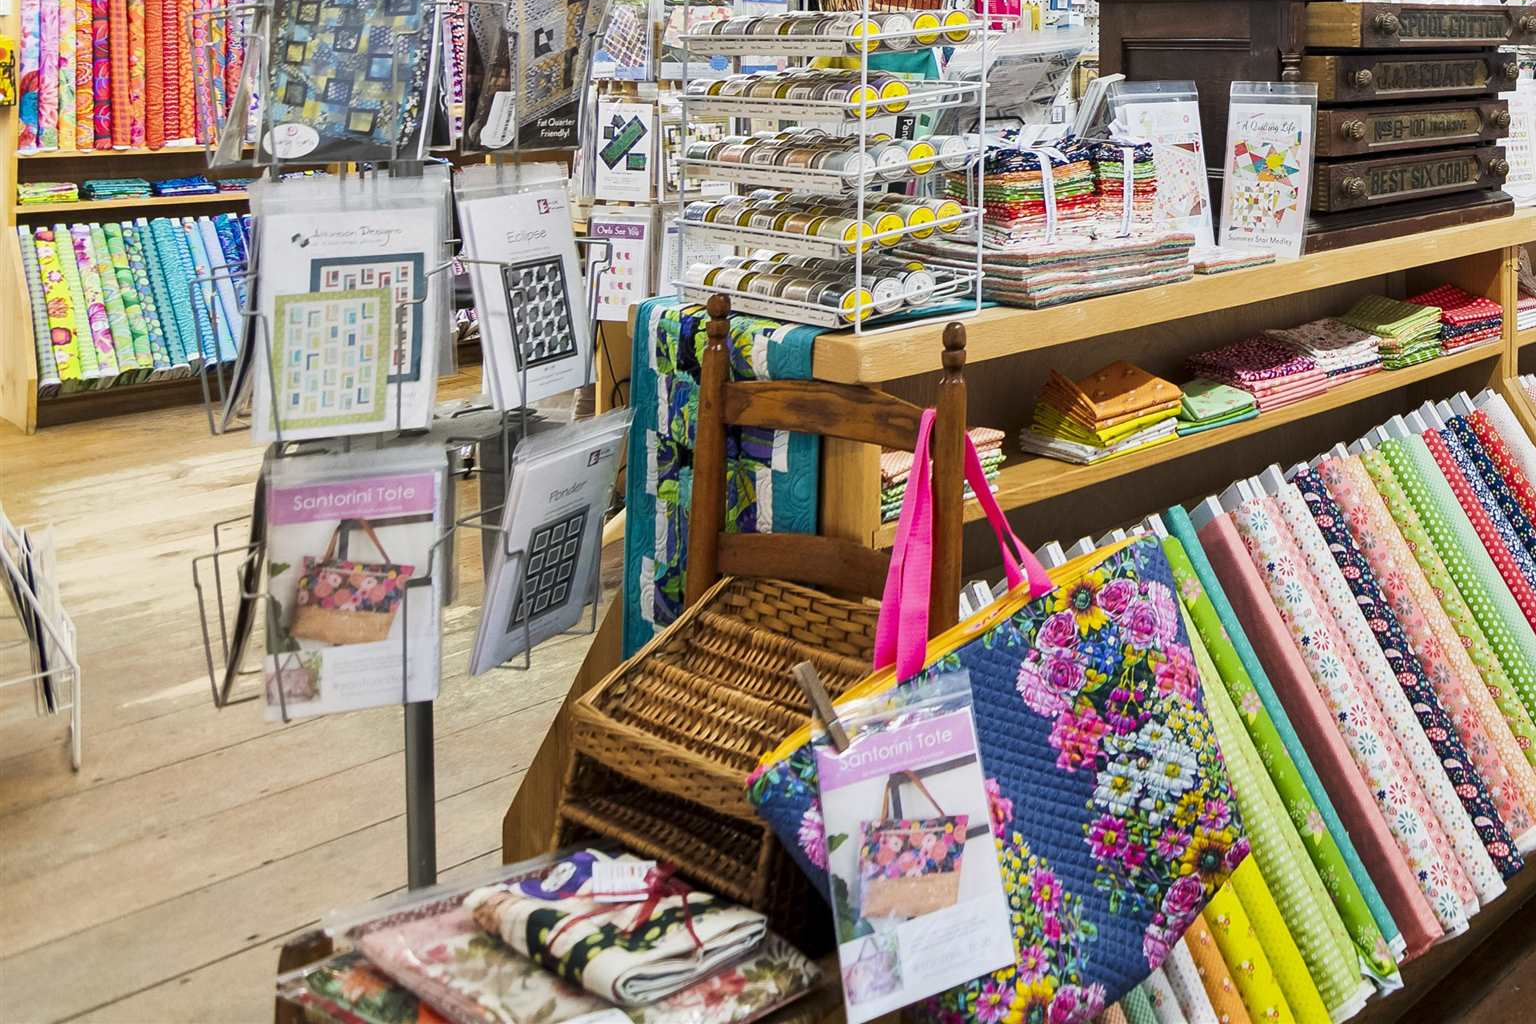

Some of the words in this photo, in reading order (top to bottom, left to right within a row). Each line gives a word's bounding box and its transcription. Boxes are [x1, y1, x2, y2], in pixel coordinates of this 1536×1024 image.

[1400, 13, 1448, 38] SPOOL
[1451, 13, 1506, 39] COTTON
[1419, 62, 1474, 88] COATS
[536, 118, 548, 127] Fat
[548, 117, 575, 127] Quarter
[541, 128, 570, 139] Friendly!
[1250, 119, 1279, 134] Quilting
[1281, 121, 1297, 134] Life
[1371, 167, 1408, 195] BEST
[1412, 164, 1435, 189] SIX
[1437, 160, 1470, 186] CORD
[506, 230, 548, 245] Eclipse
[293, 488, 373, 512] Santorini
[376, 484, 416, 502] Tote
[549, 480, 587, 504] Ponder
[839, 737, 913, 771] Santorini
[917, 729, 953, 749] Tote
